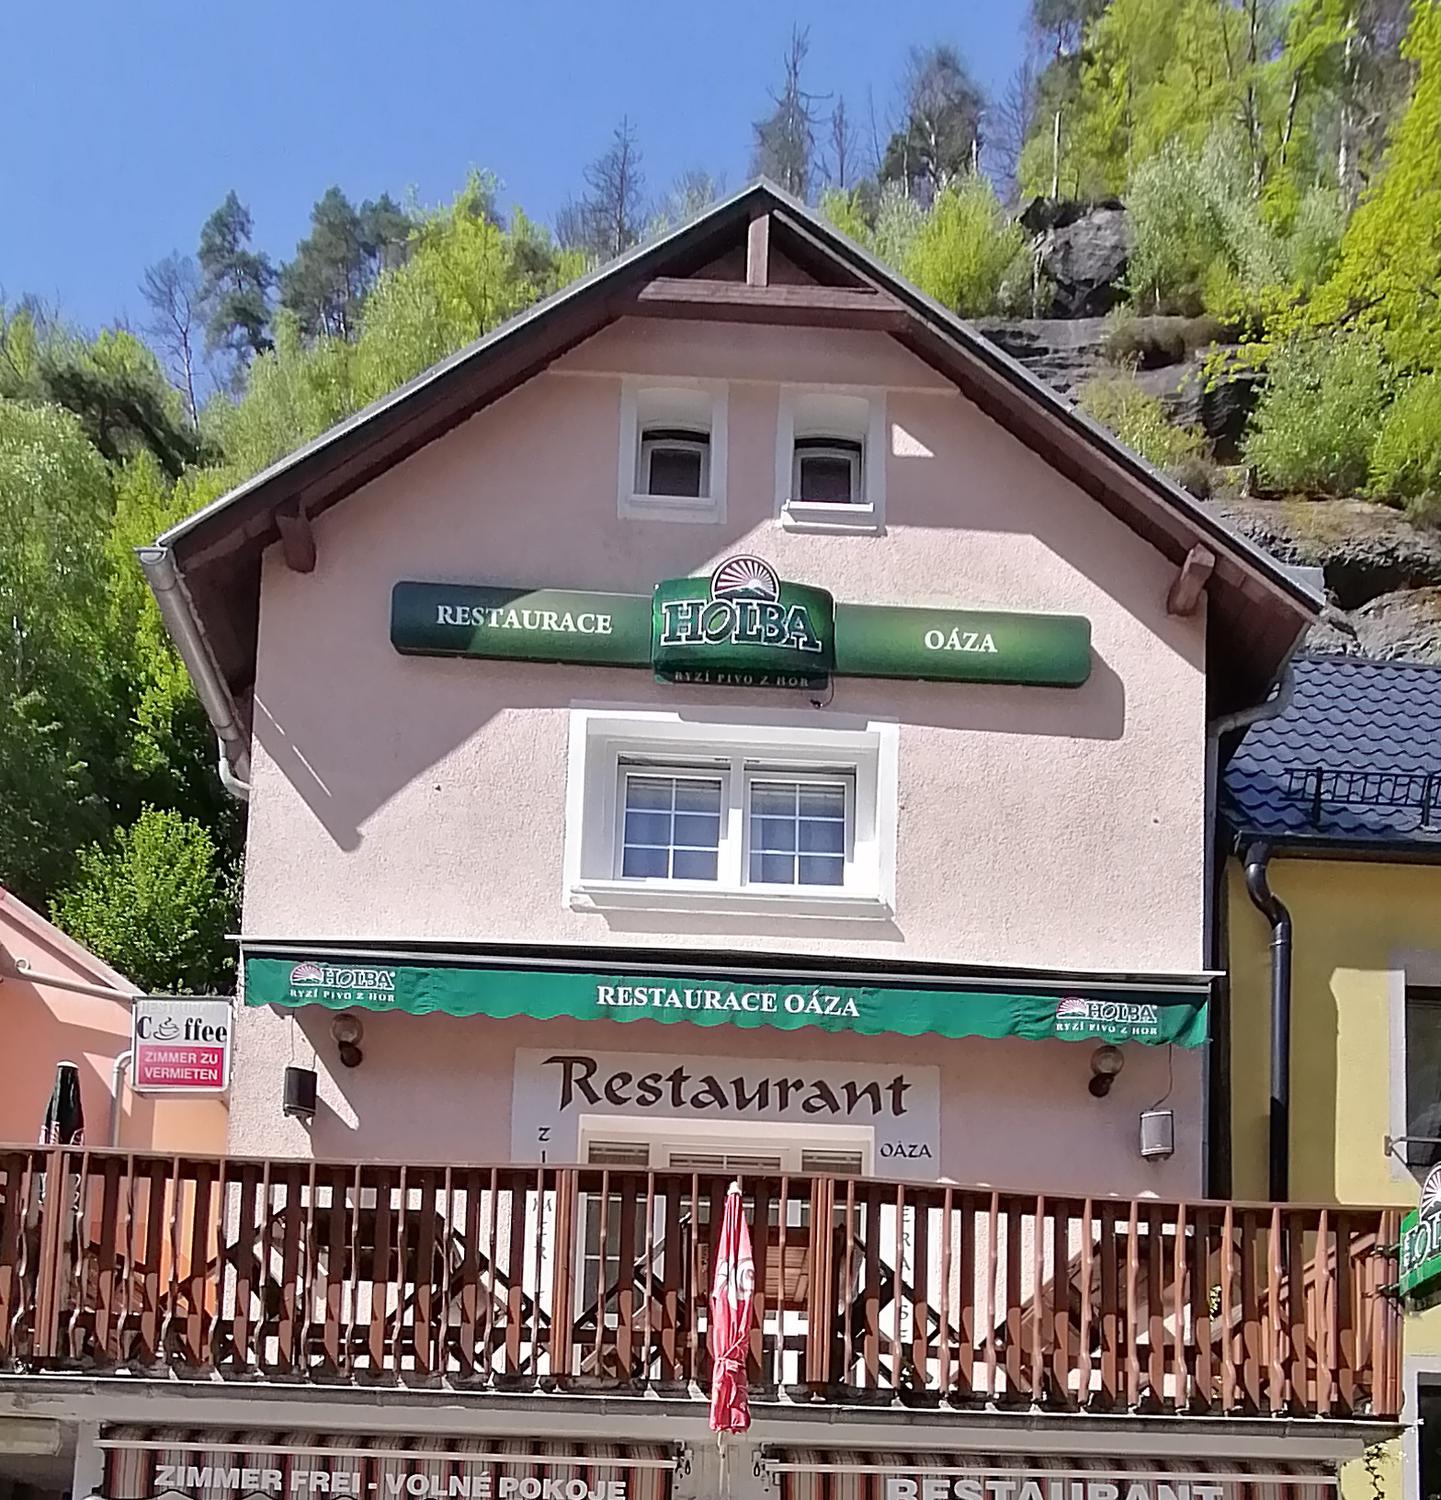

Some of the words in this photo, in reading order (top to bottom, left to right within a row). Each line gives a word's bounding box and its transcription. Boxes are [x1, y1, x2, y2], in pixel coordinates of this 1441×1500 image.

[436, 605, 612, 634] RESTAURACE
[660, 599, 821, 653] HOLBA
[924, 628, 997, 653] OÁZA
[717, 672, 753, 685] PIVO
[759, 675, 770, 685] Z
[320, 967, 396, 990] HOLBA
[597, 985, 777, 1013] RESTAURACE
[784, 989, 860, 1018] OÁZA
[1085, 1000, 1158, 1024] HOLBA
[144, 1051, 197, 1064] ZIMMER
[200, 1053, 218, 1065] ZU
[144, 1067, 218, 1080] VERMIETEN
[541, 1055, 911, 1117] Restaurant
[880, 1141, 932, 1159] OÁZA
[154, 1465, 282, 1491] ZIMMER
[290, 1470, 361, 1494] FREI
[385, 1471, 492, 1498] VOLNÉ
